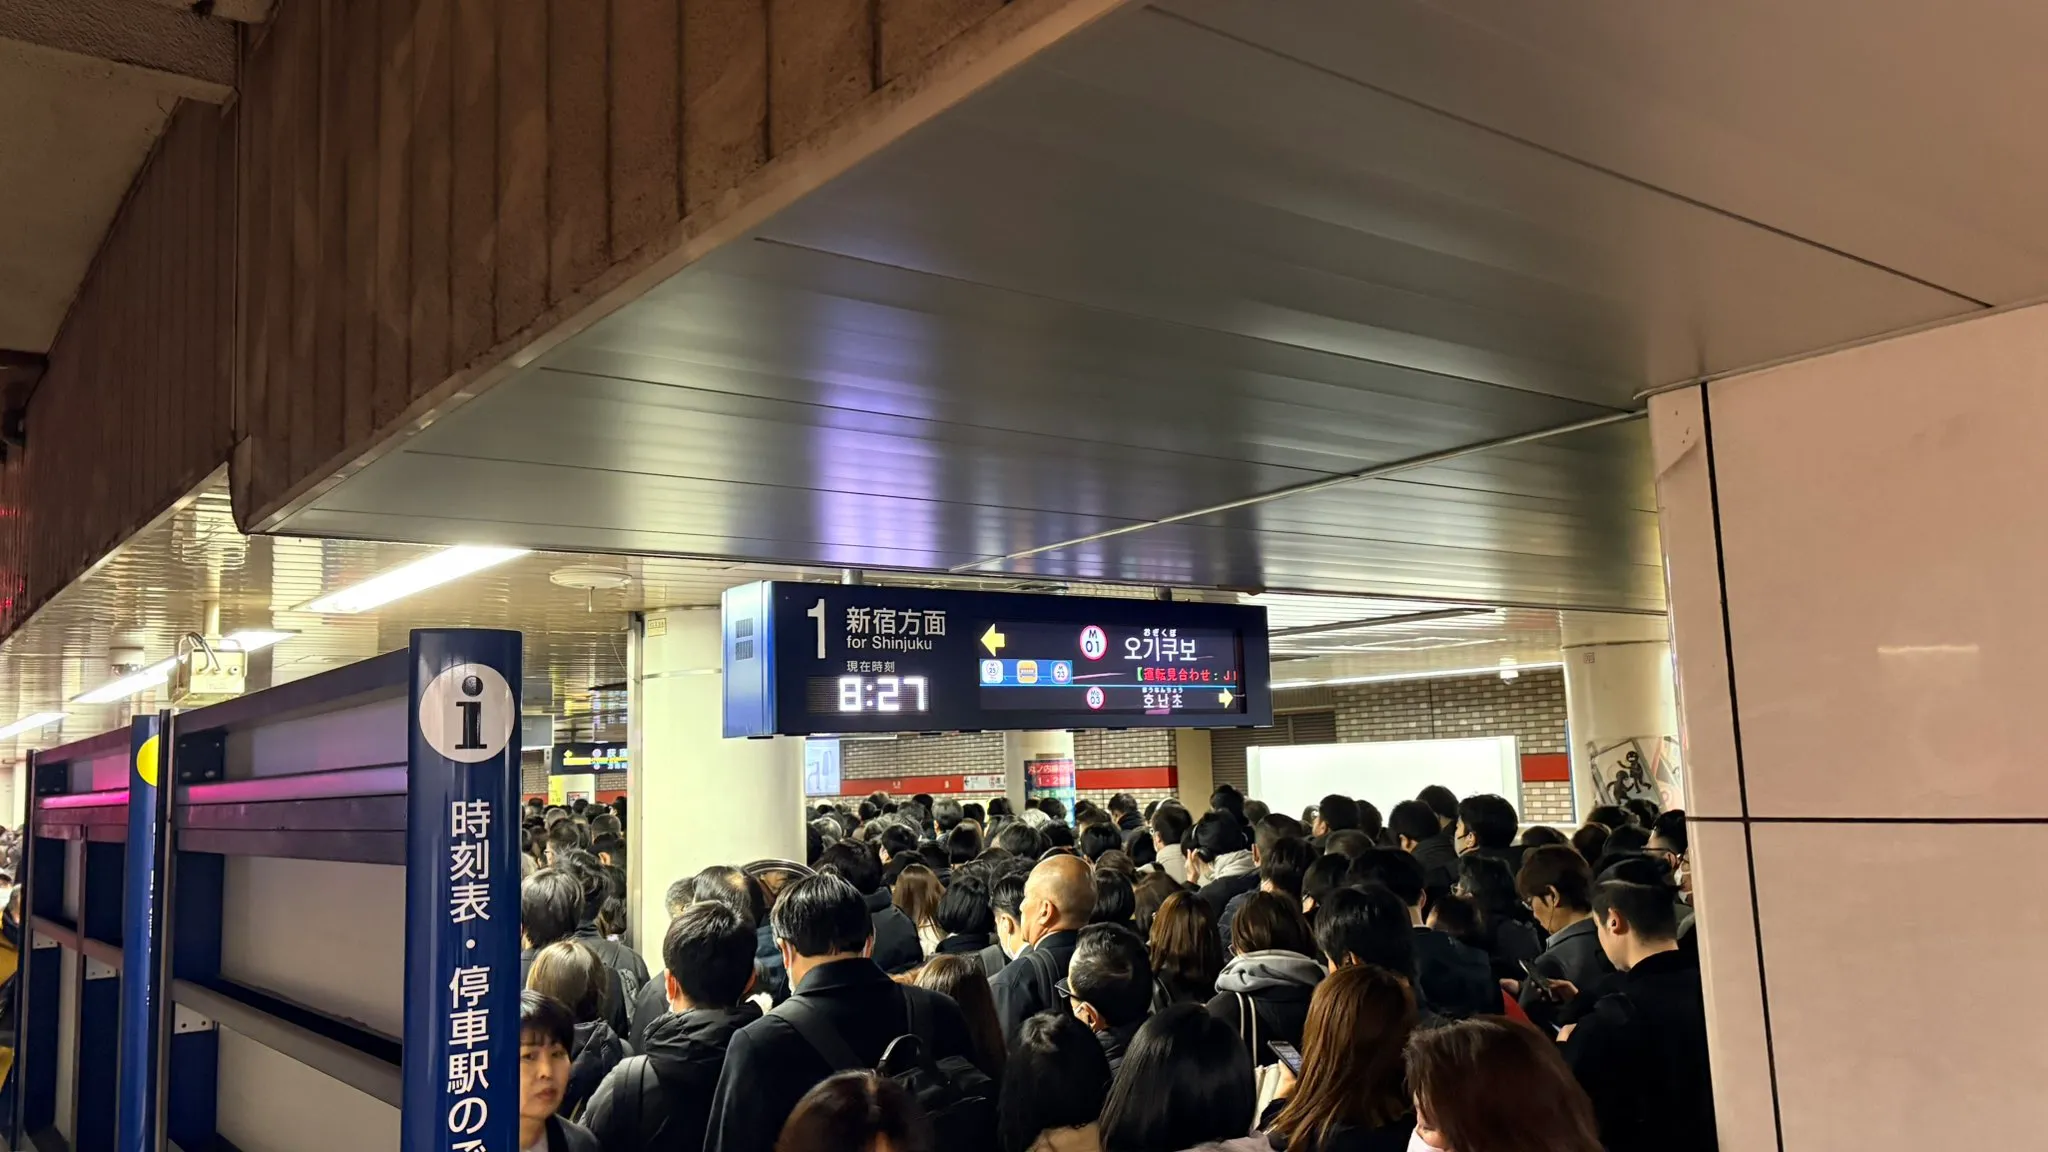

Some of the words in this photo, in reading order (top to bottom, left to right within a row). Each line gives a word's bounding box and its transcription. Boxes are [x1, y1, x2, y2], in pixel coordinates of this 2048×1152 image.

[807, 598, 826, 659] 1
[846, 606, 946, 636] 新宿方面
[1088, 629, 1098, 639] M
[1143, 628, 1177, 637] おぎくぼ
[846, 635, 867, 649] for
[872, 635, 932, 653] Shinjuku
[1085, 640, 1100, 653] 01
[1124, 636, 1198, 662] 오기쿠보
[846, 660, 895, 673] 現在時刻
[838, 675, 925, 712] 8:27
[1090, 696, 1101, 705] 03
[1143, 693, 1183, 709] 호난초
